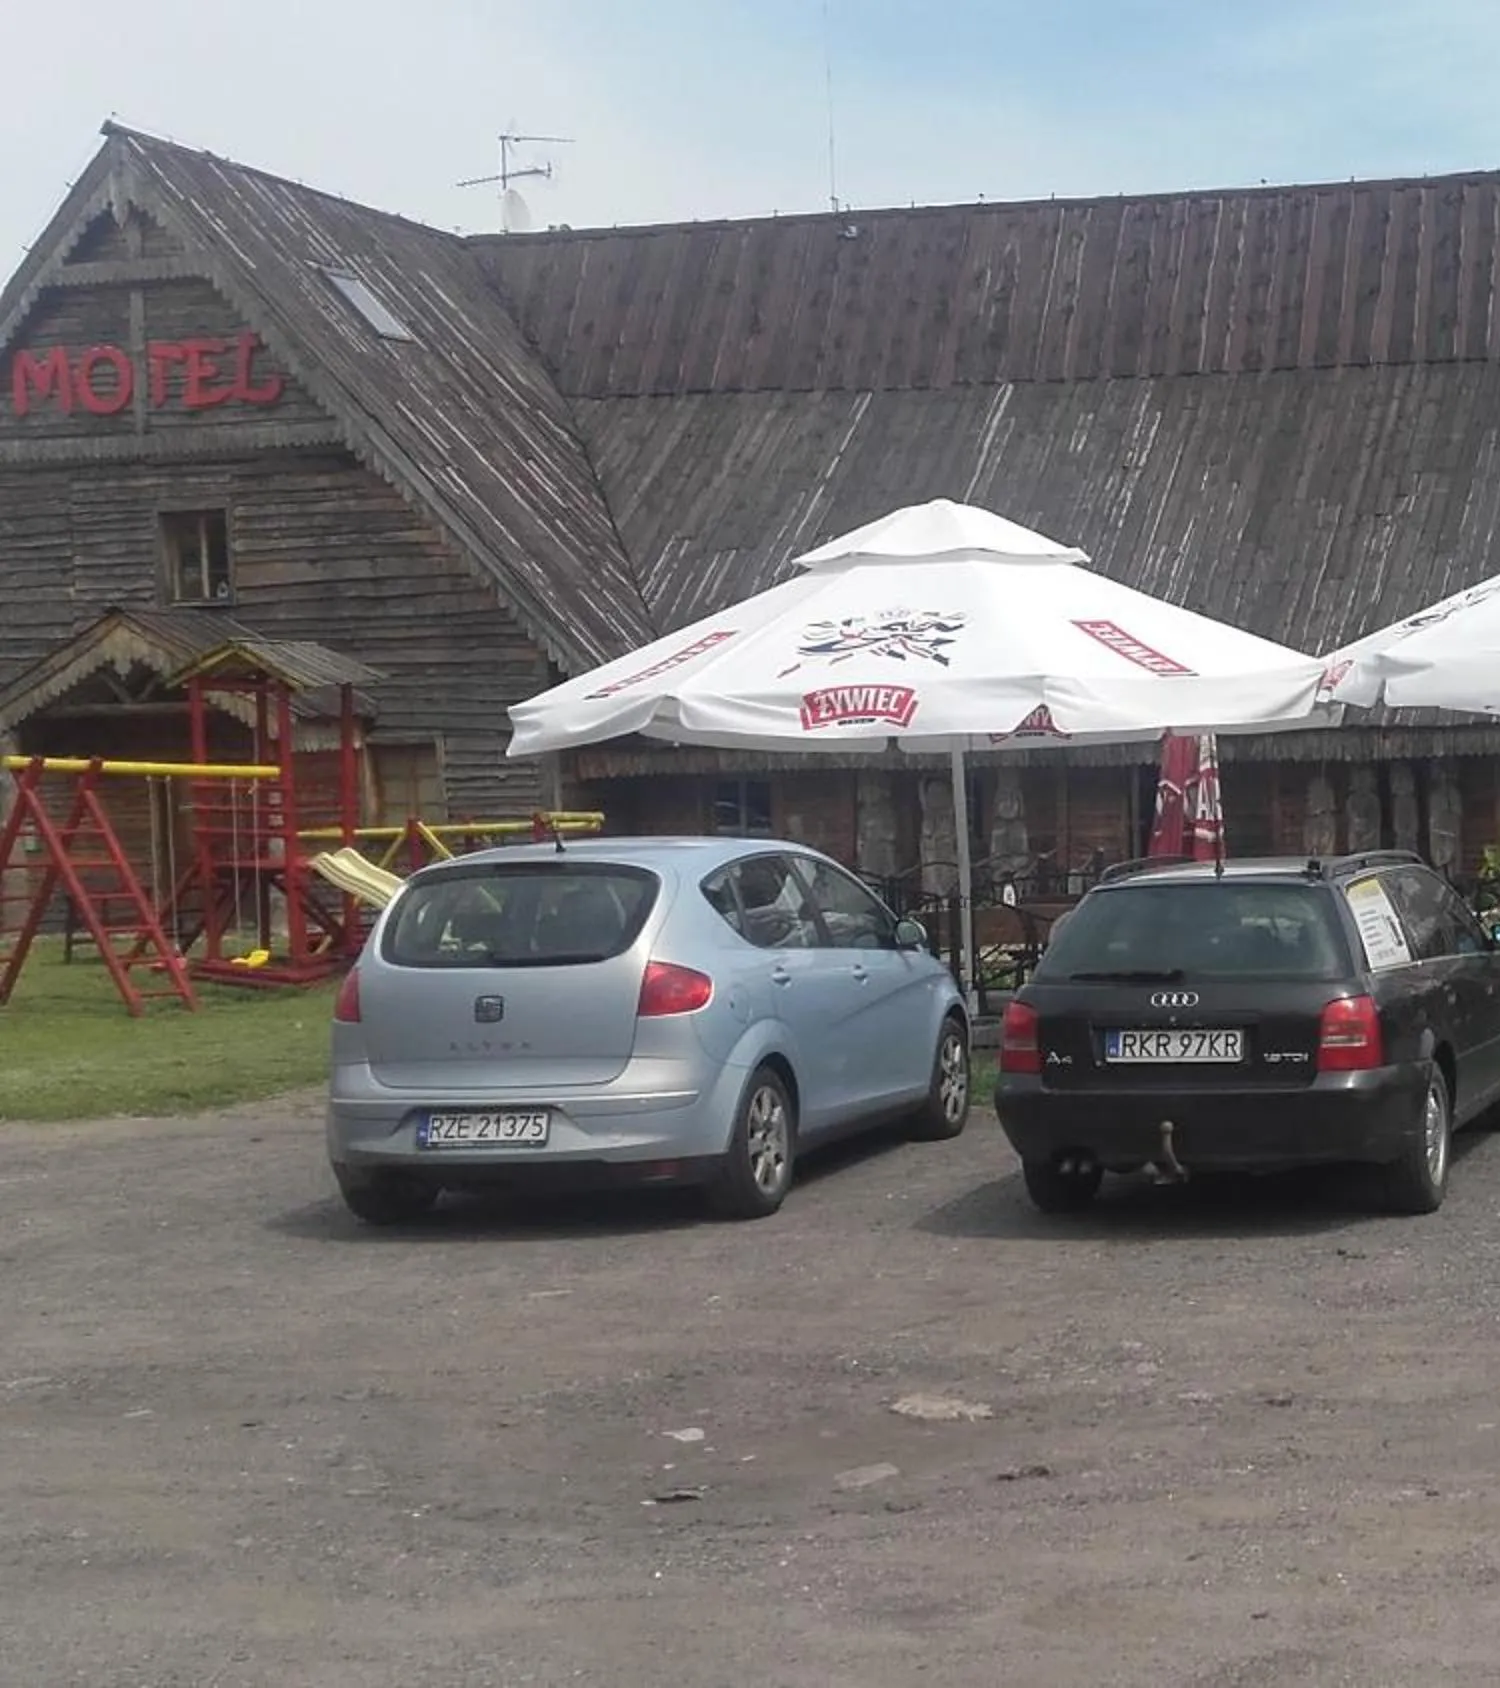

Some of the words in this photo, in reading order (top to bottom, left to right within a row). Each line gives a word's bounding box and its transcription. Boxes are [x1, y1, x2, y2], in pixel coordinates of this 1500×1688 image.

[11, 328, 286, 417] MOTEL
[1122, 1033, 1171, 1058] RKR
[1179, 1032, 1240, 1057] 97KR
[429, 1116, 470, 1139] RZE
[477, 1114, 545, 1138] 21375
